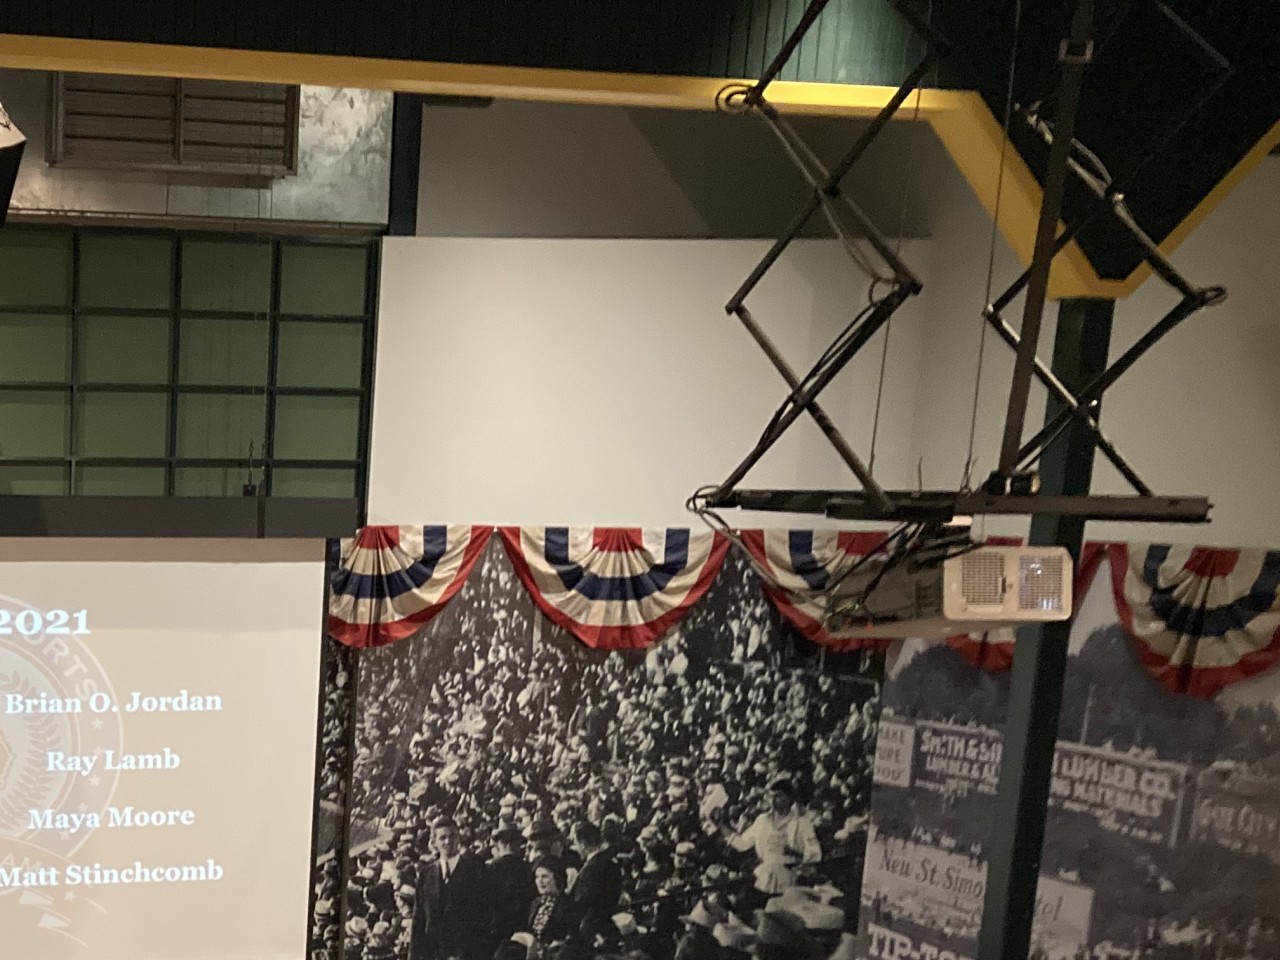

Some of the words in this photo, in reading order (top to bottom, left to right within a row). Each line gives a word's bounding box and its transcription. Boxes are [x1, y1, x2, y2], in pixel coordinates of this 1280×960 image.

[4, 691, 83, 714] Brian
[89, 691, 118, 713] O.
[125, 689, 223, 712] Jordan
[46, 750, 98, 776] Ray
[104, 748, 181, 770] Lamb
[26, 808, 100, 833] Maya
[107, 806, 195, 828] Moore
[65, 858, 224, 885] Stinchcomb
